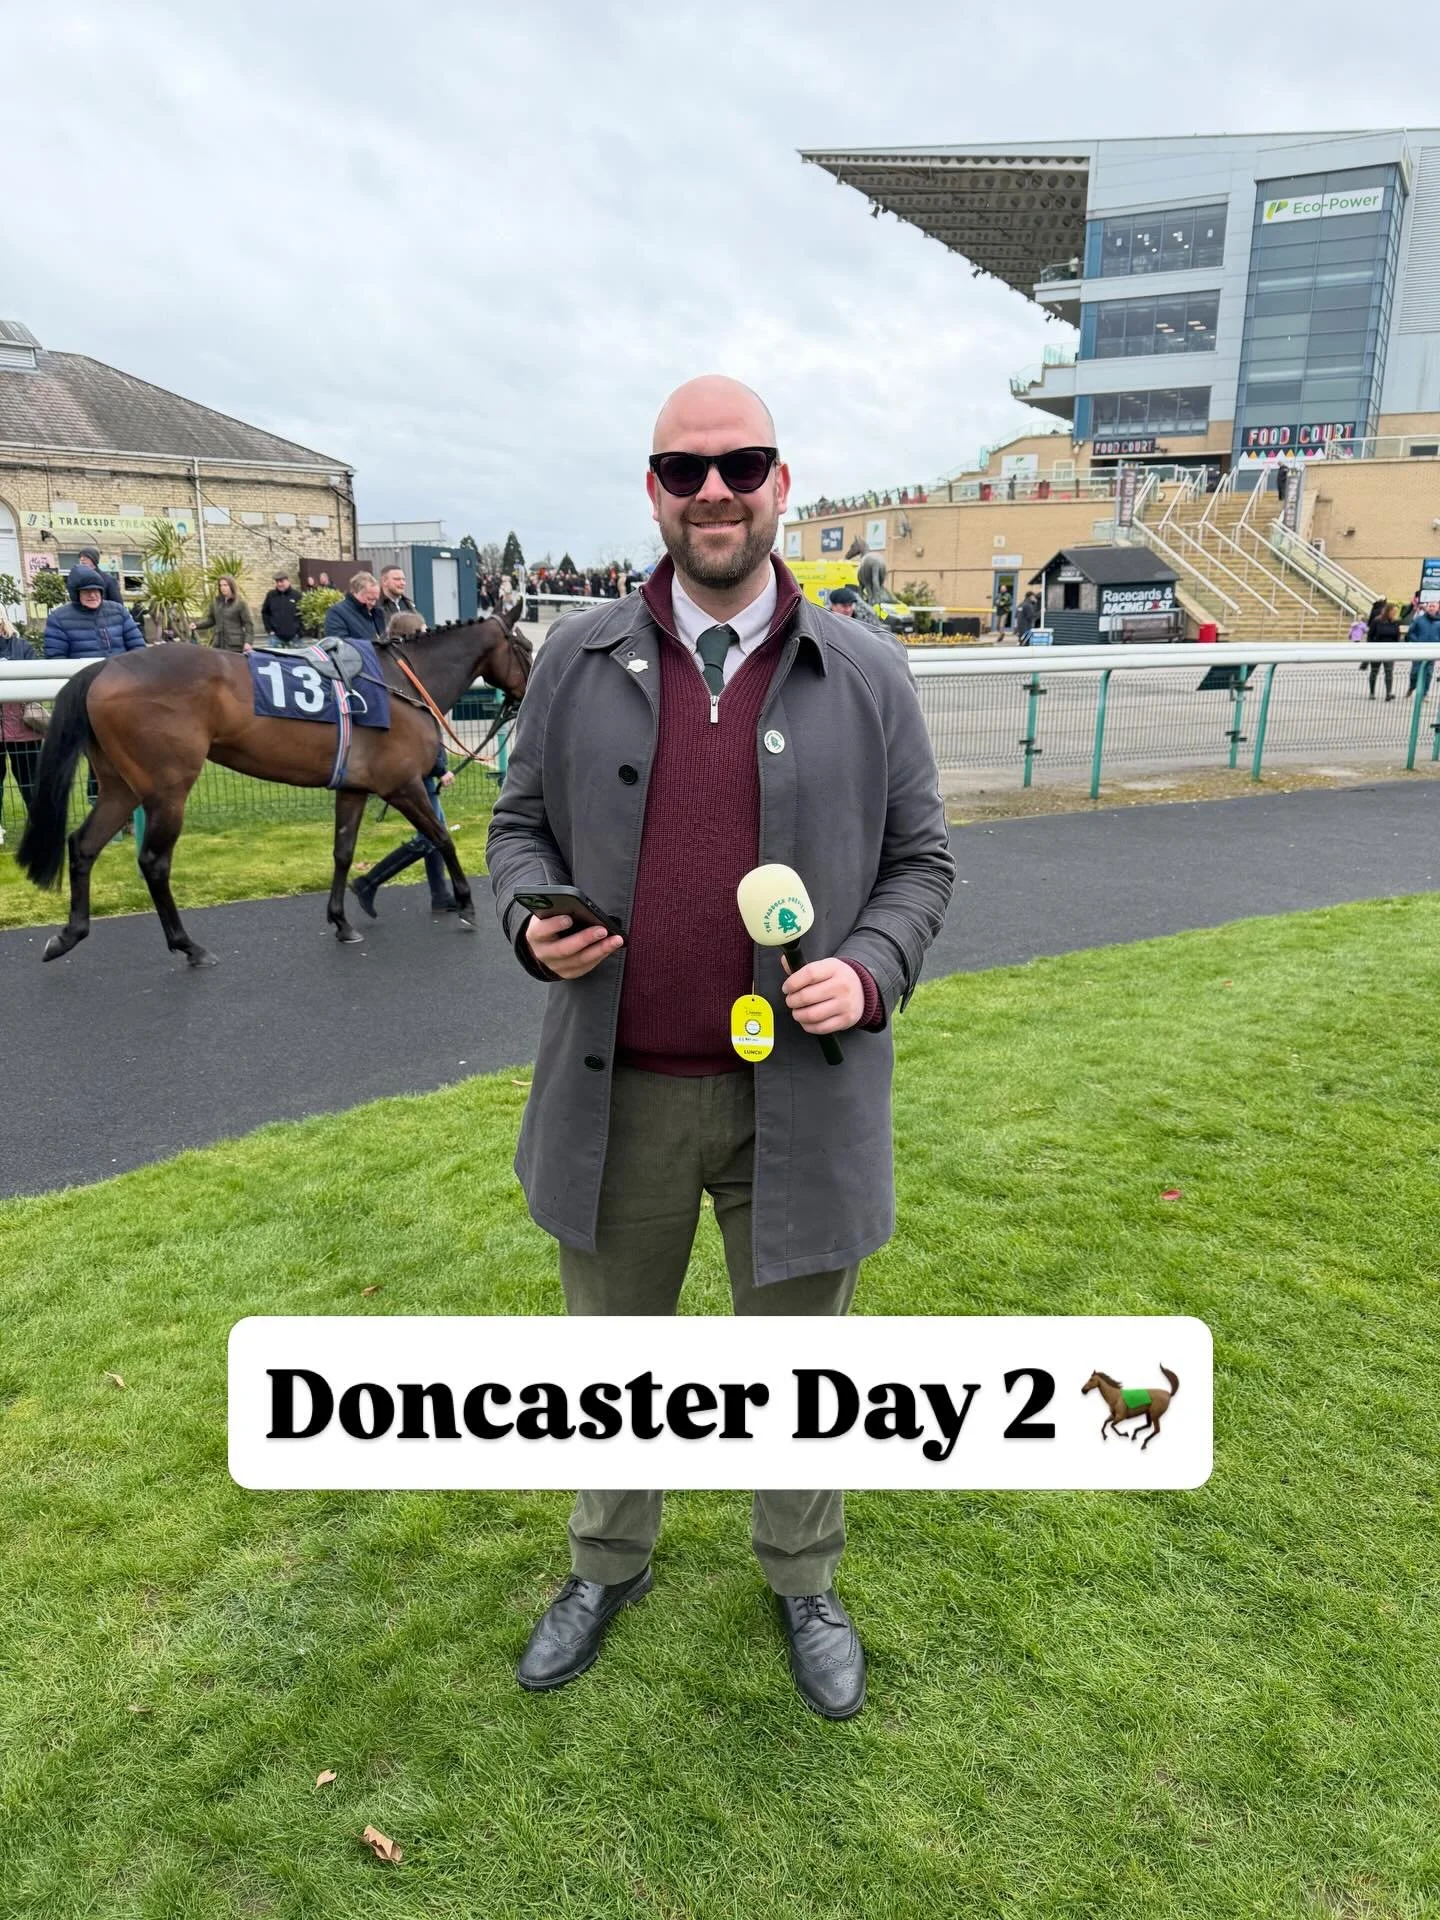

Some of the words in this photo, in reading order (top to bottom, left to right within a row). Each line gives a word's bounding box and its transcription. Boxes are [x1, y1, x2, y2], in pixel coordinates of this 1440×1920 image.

[1293, 194, 1379, 215] Eco-Power
[1247, 426, 1291, 446] FOOD
[1298, 423, 1354, 445] COURT
[1095, 441, 1120, 454] FOOD
[1121, 440, 1155, 453] COURT
[58, 517, 116, 527] TRACKSIDE
[1102, 587, 1163, 603] Racecards
[1165, 587, 1173, 600] &
[1102, 601, 1144, 615] RACING
[257, 661, 325, 713] 13
